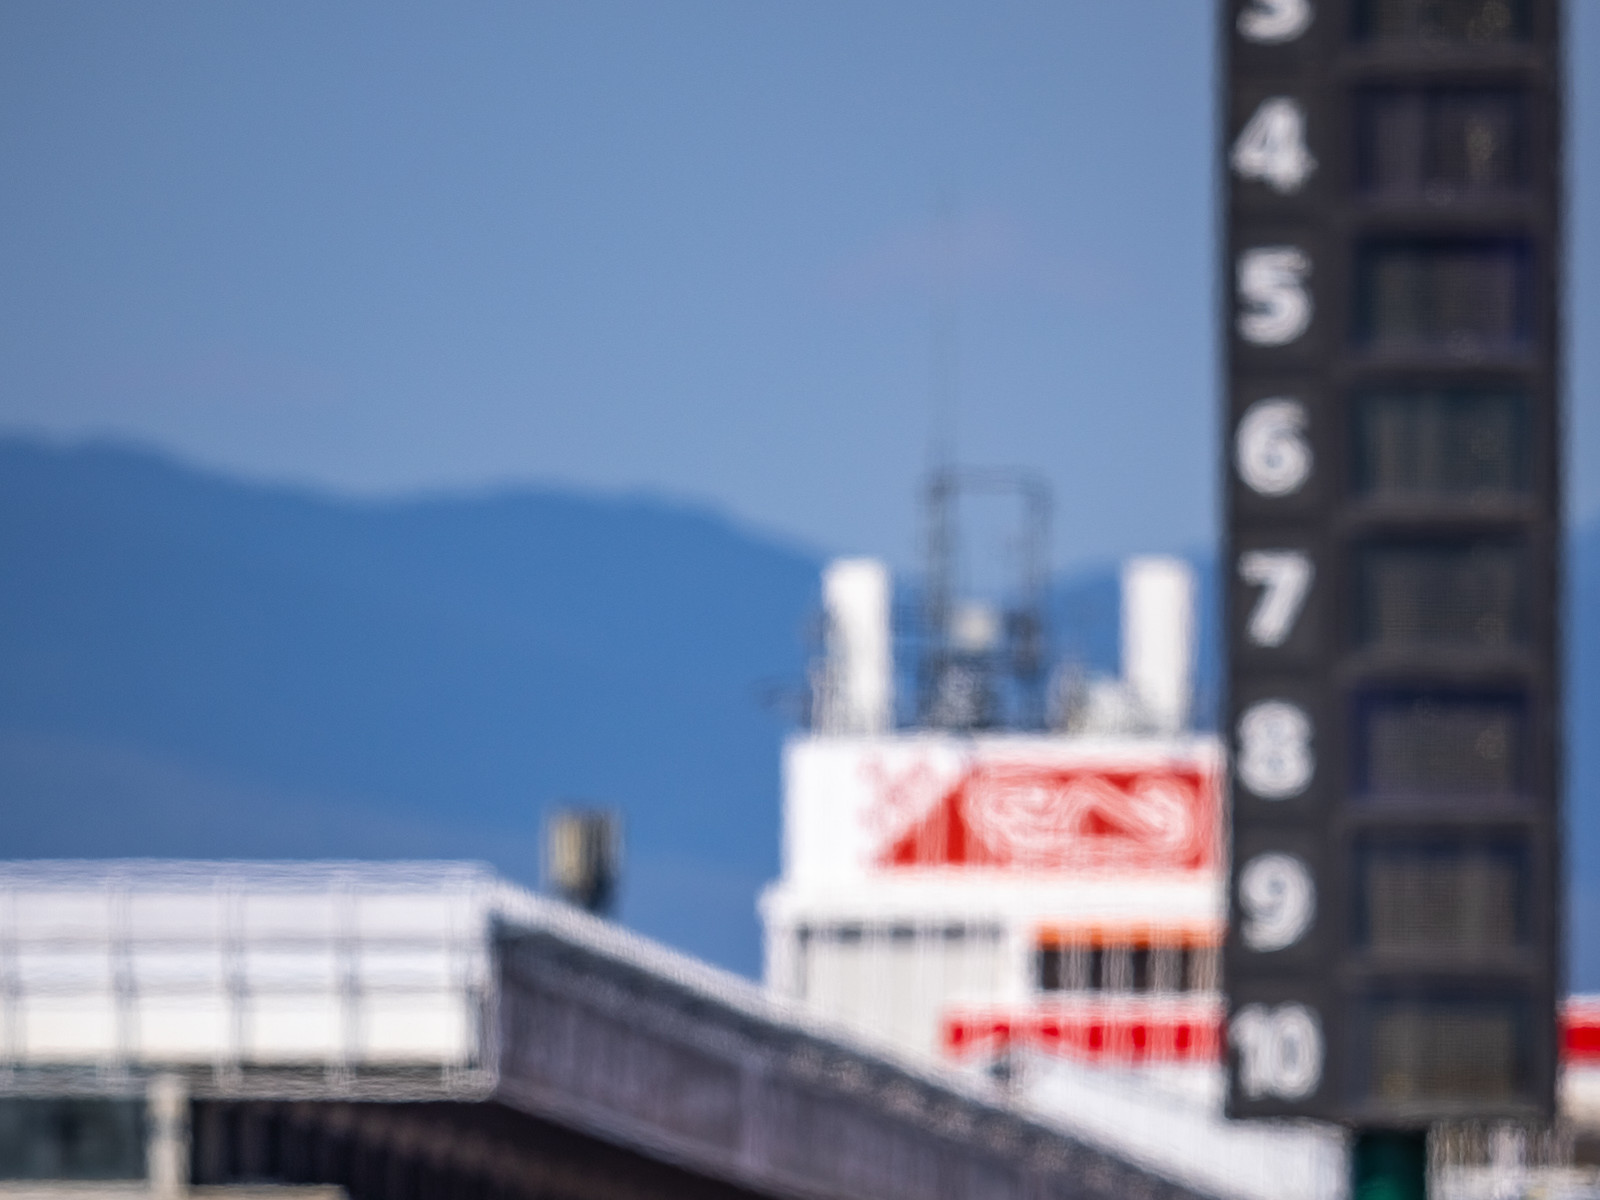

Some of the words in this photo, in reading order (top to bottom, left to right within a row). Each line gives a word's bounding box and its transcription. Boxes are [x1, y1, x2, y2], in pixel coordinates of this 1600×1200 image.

[1233, 97, 1316, 191] 4
[1237, 246, 1313, 347] 5
[1235, 398, 1313, 495] 6
[1238, 549, 1315, 647] 7
[1237, 701, 1315, 799] 8
[1238, 853, 1316, 952] 9
[1229, 1003, 1325, 1098] 10
